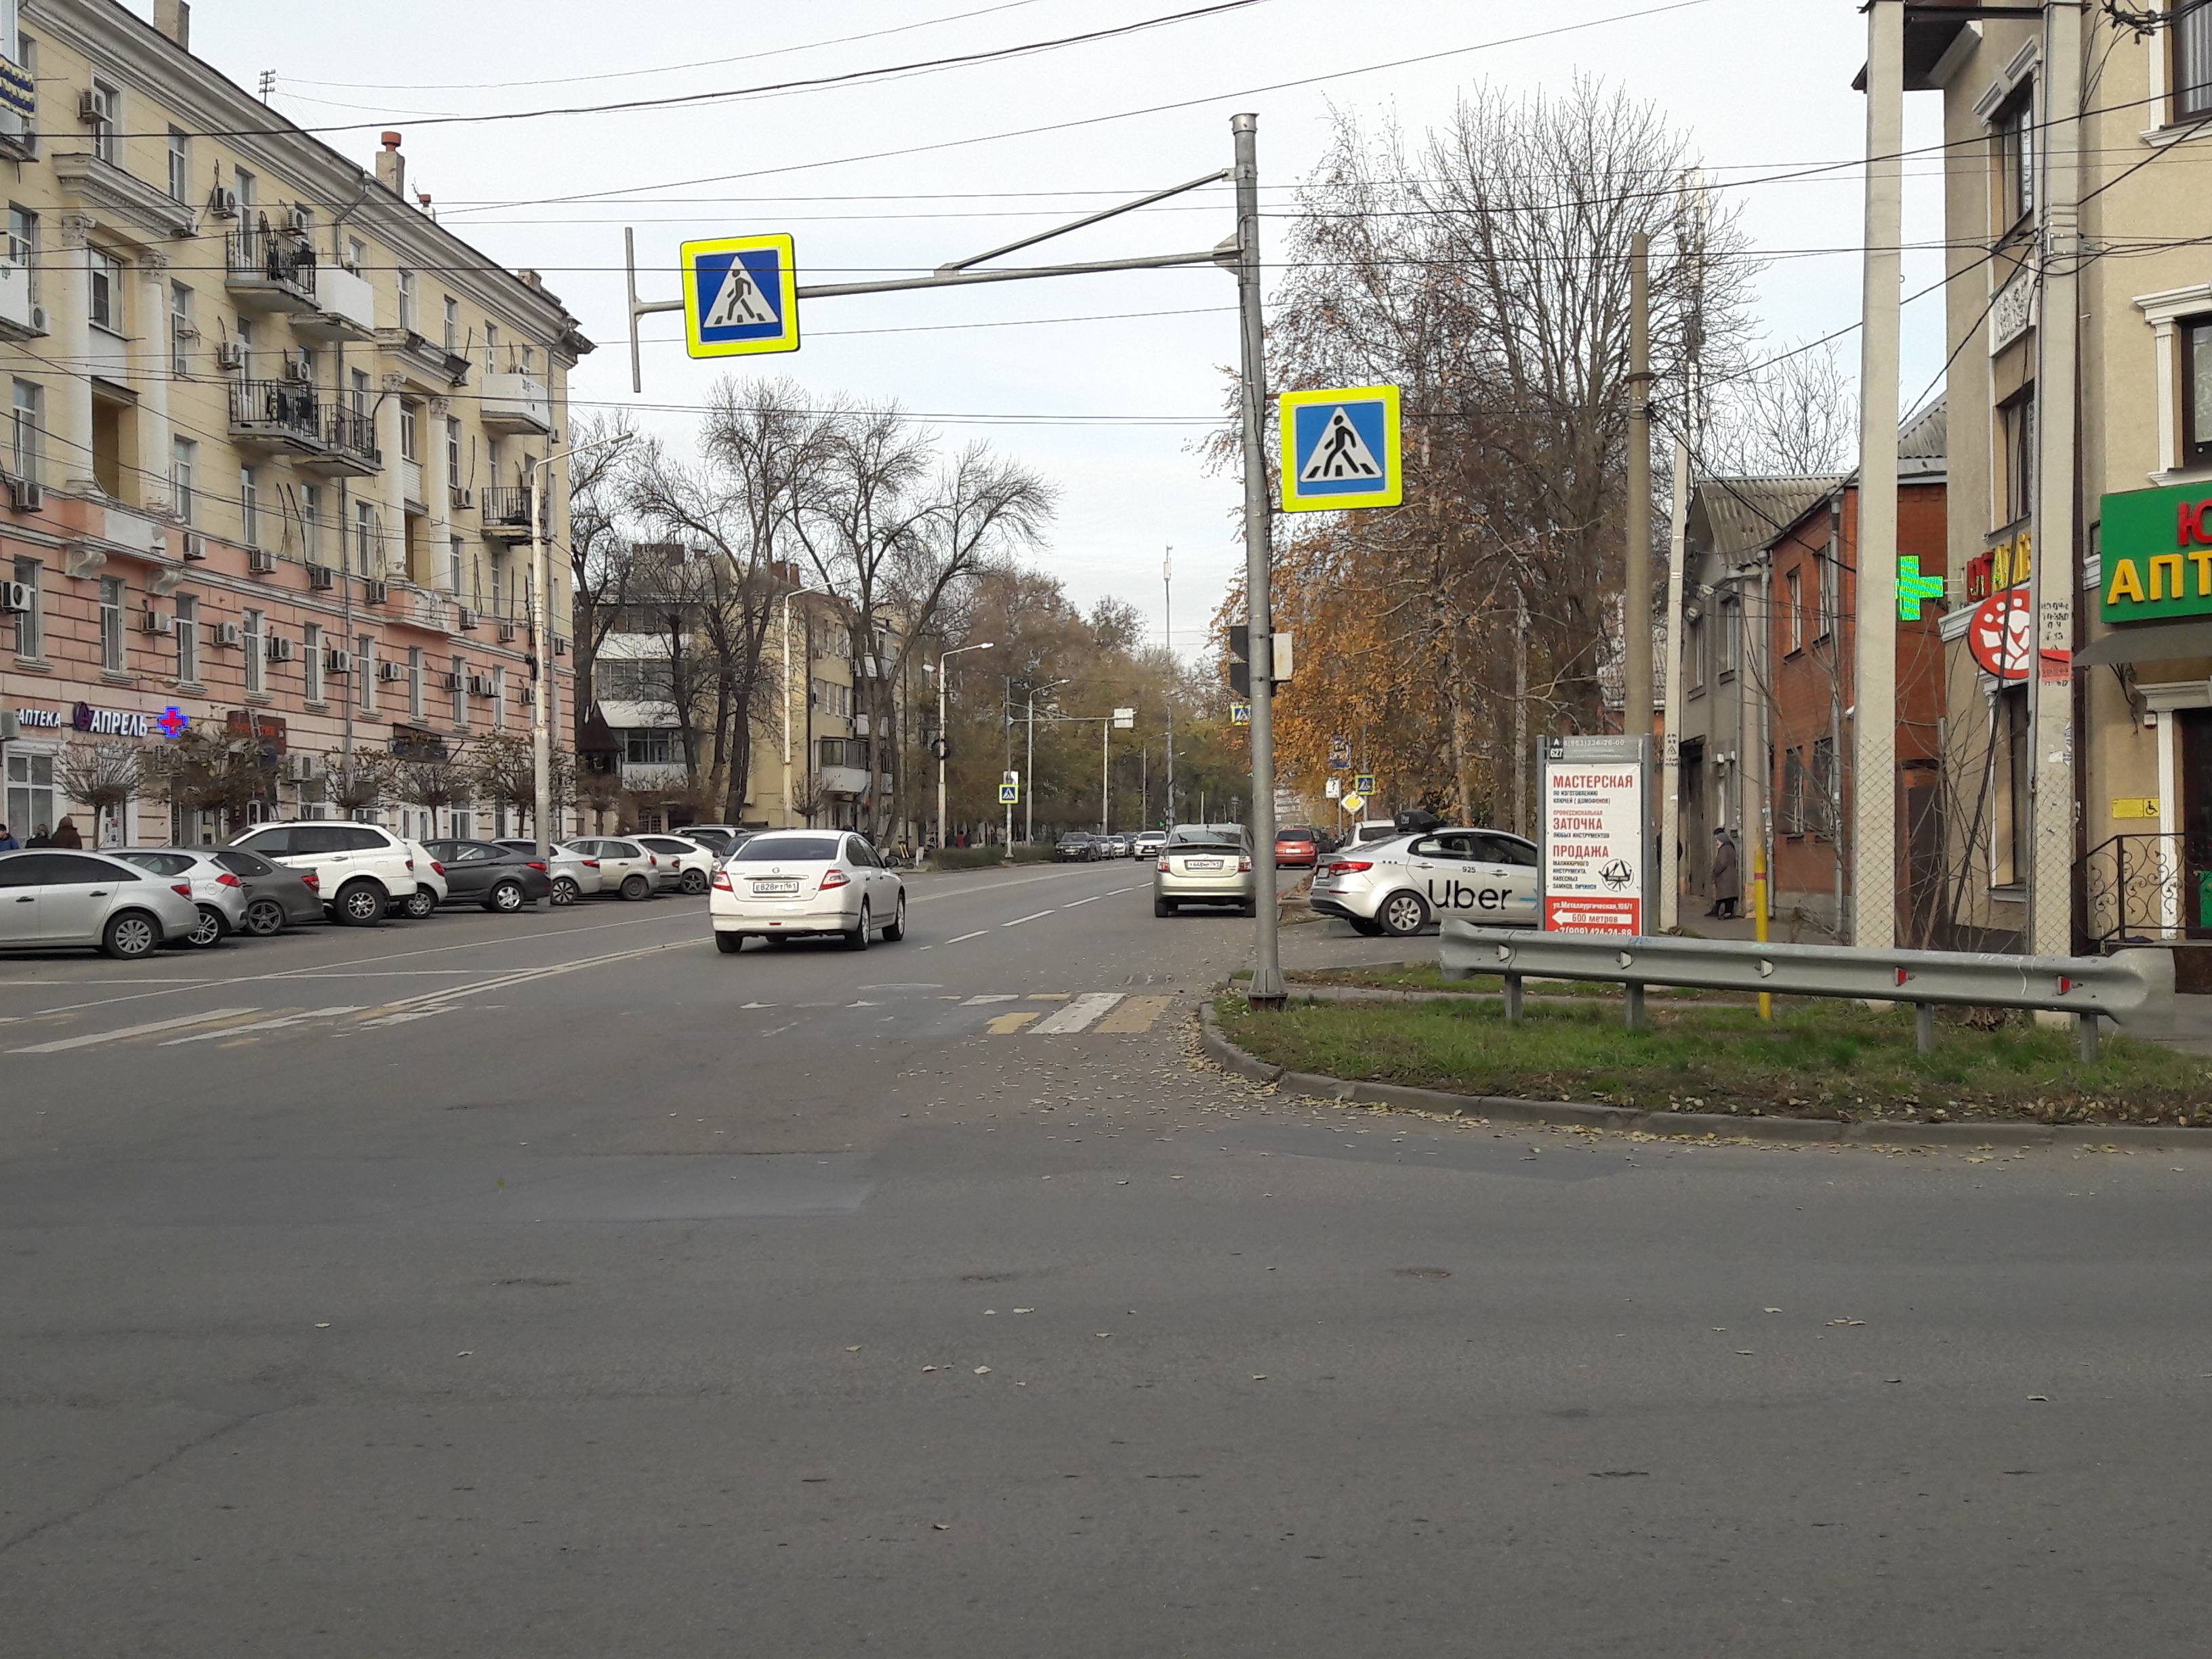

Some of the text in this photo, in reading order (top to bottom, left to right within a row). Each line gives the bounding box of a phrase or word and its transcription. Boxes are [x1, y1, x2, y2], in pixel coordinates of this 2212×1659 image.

[2106, 550, 2212, 605] АПТ
[18, 709, 148, 737] АПТЕКА АПРЕЛЬ
[1550, 747, 1563, 758] 627
[1553, 775, 1633, 788] МАСТЕРСКАЯ
[1553, 817, 1603, 830] ЗАТОЧКА
[1553, 845, 1609, 859] ПРОДАЖА
[1429, 879, 1512, 910] Uber
[1572, 914, 1618, 924] 600 метров
